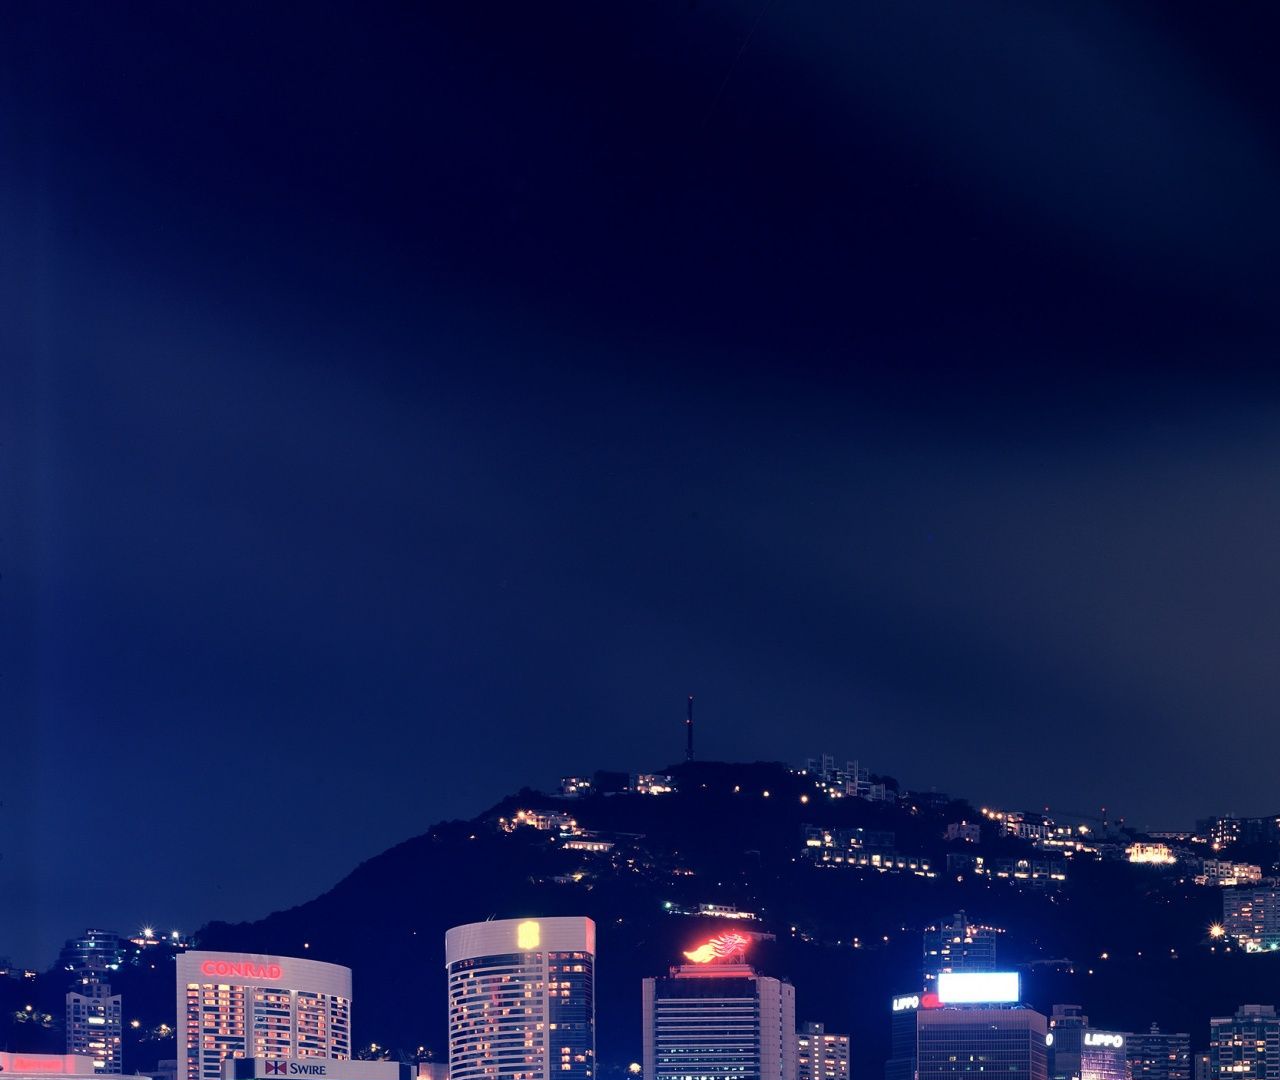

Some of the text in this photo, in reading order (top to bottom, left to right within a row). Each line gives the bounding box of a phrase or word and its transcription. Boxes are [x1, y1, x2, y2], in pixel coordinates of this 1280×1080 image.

[201, 959, 283, 980] CONRAD
[893, 996, 919, 1011] LIPPO
[1084, 1033, 1123, 1048] LIPPO
[290, 1062, 327, 1076] SWIRE
